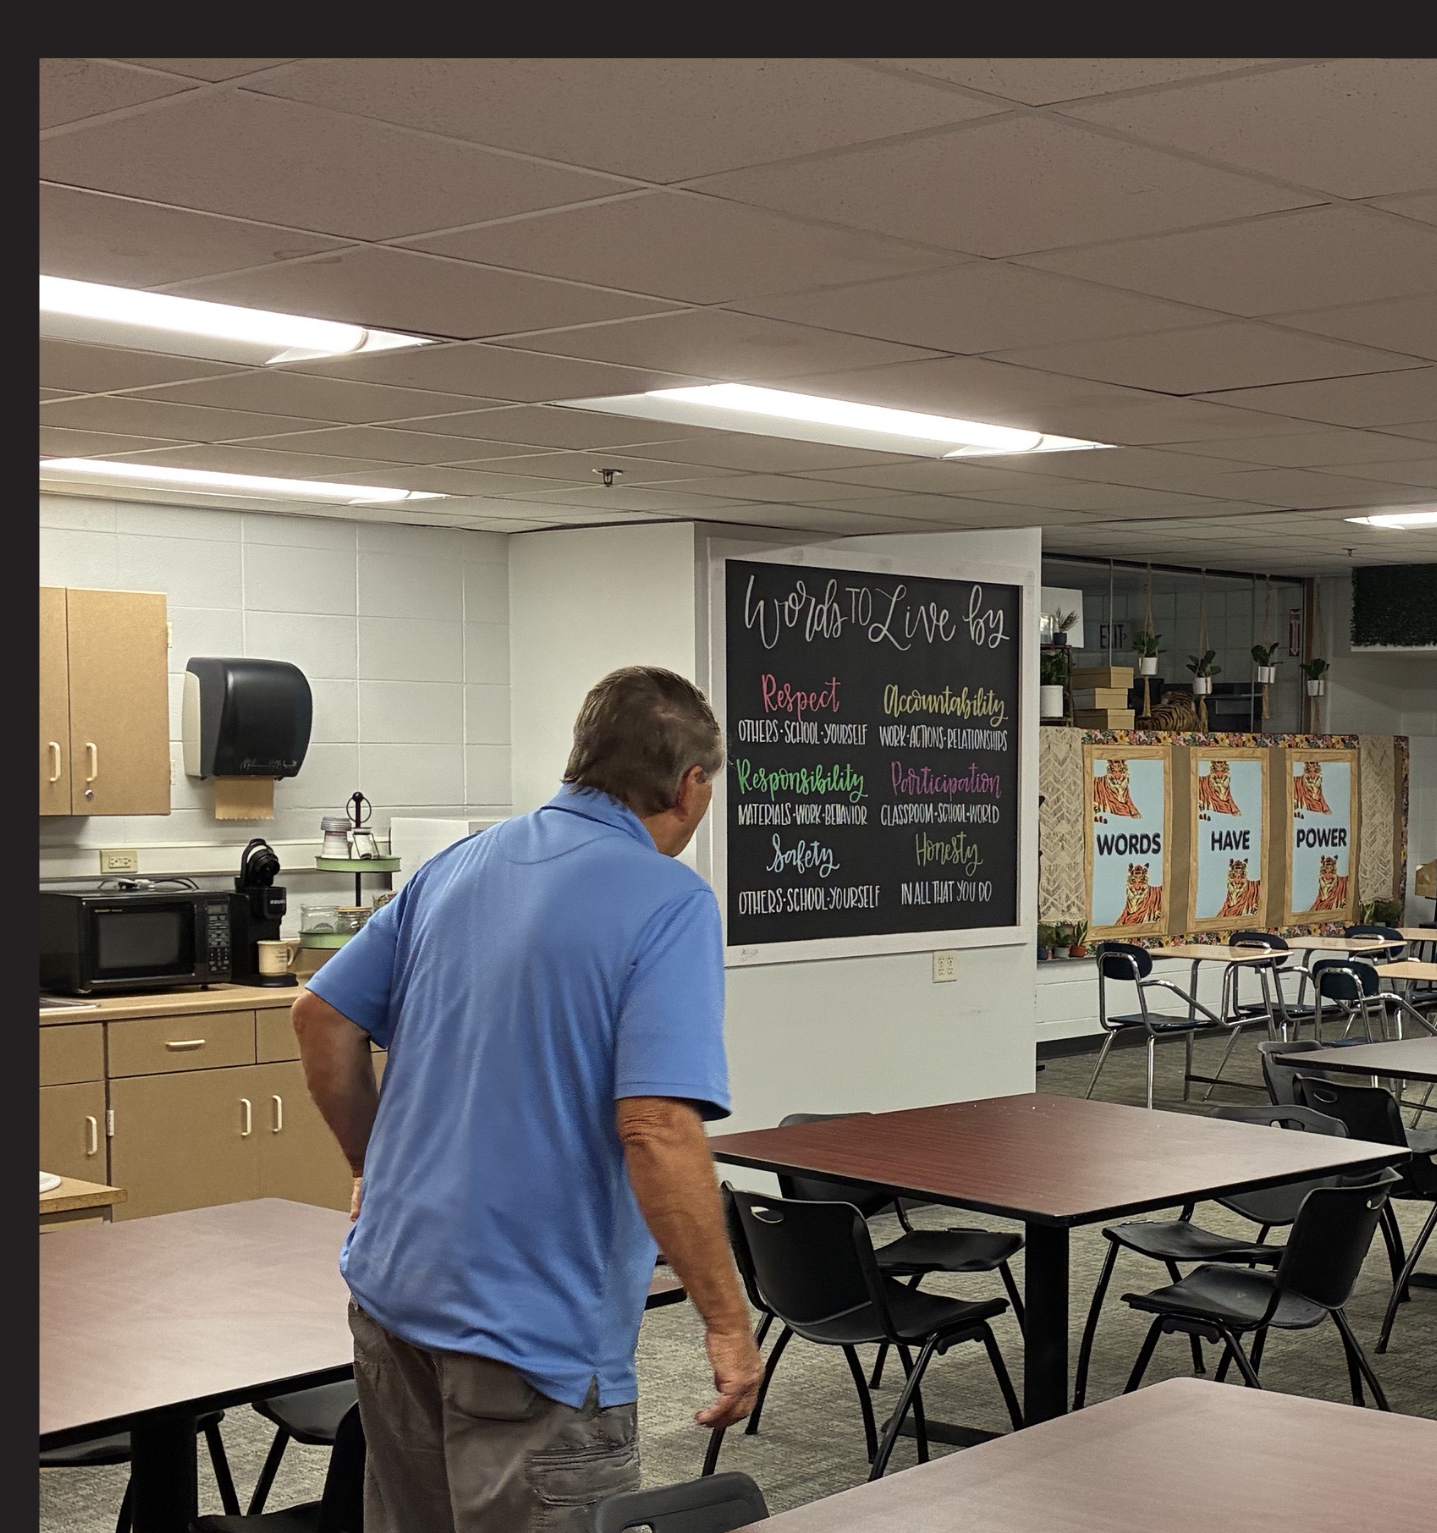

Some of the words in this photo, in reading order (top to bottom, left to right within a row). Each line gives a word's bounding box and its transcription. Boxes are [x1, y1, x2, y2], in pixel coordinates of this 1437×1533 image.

[744, 575, 847, 649] Words
[846, 587, 871, 625] TO
[869, 585, 956, 651] Live
[962, 585, 1010, 648] by
[762, 673, 840, 721] Respect
[884, 684, 1008, 727] Accountability
[738, 719, 778, 743] OTHERS
[784, 720, 820, 745] SCHOOL
[824, 724, 868, 746] YOURSELF
[879, 725, 907, 748] WORK
[909, 725, 945, 750] ACTIONS
[947, 729, 1008, 751] RELATIONSHIPS
[736, 759, 868, 803] Responsibility
[891, 761, 1001, 801] Participation
[738, 804, 791, 826] MATERIALS
[795, 804, 822, 825] WORK
[825, 804, 868, 826] BEHAVIOR
[881, 804, 935, 826] CLASSROOM
[937, 804, 967, 824] SCHOOL
[970, 804, 1000, 824] WORLD
[1096, 832, 1162, 856] WORDS
[1211, 829, 1251, 851] HAVE
[1296, 828, 1347, 848] POWER
[767, 833, 840, 878] Safety
[915, 831, 983, 876] Honesty
[739, 889, 783, 915] OTHERS
[787, 887, 828, 912] SCHOOL
[829, 885, 881, 910] YOURSELF
[902, 882, 913, 905] IN
[914, 882, 931, 904] ALL
[932, 881, 953, 904] THAT
[956, 881, 976, 903] YOU
[978, 881, 992, 902] DO
